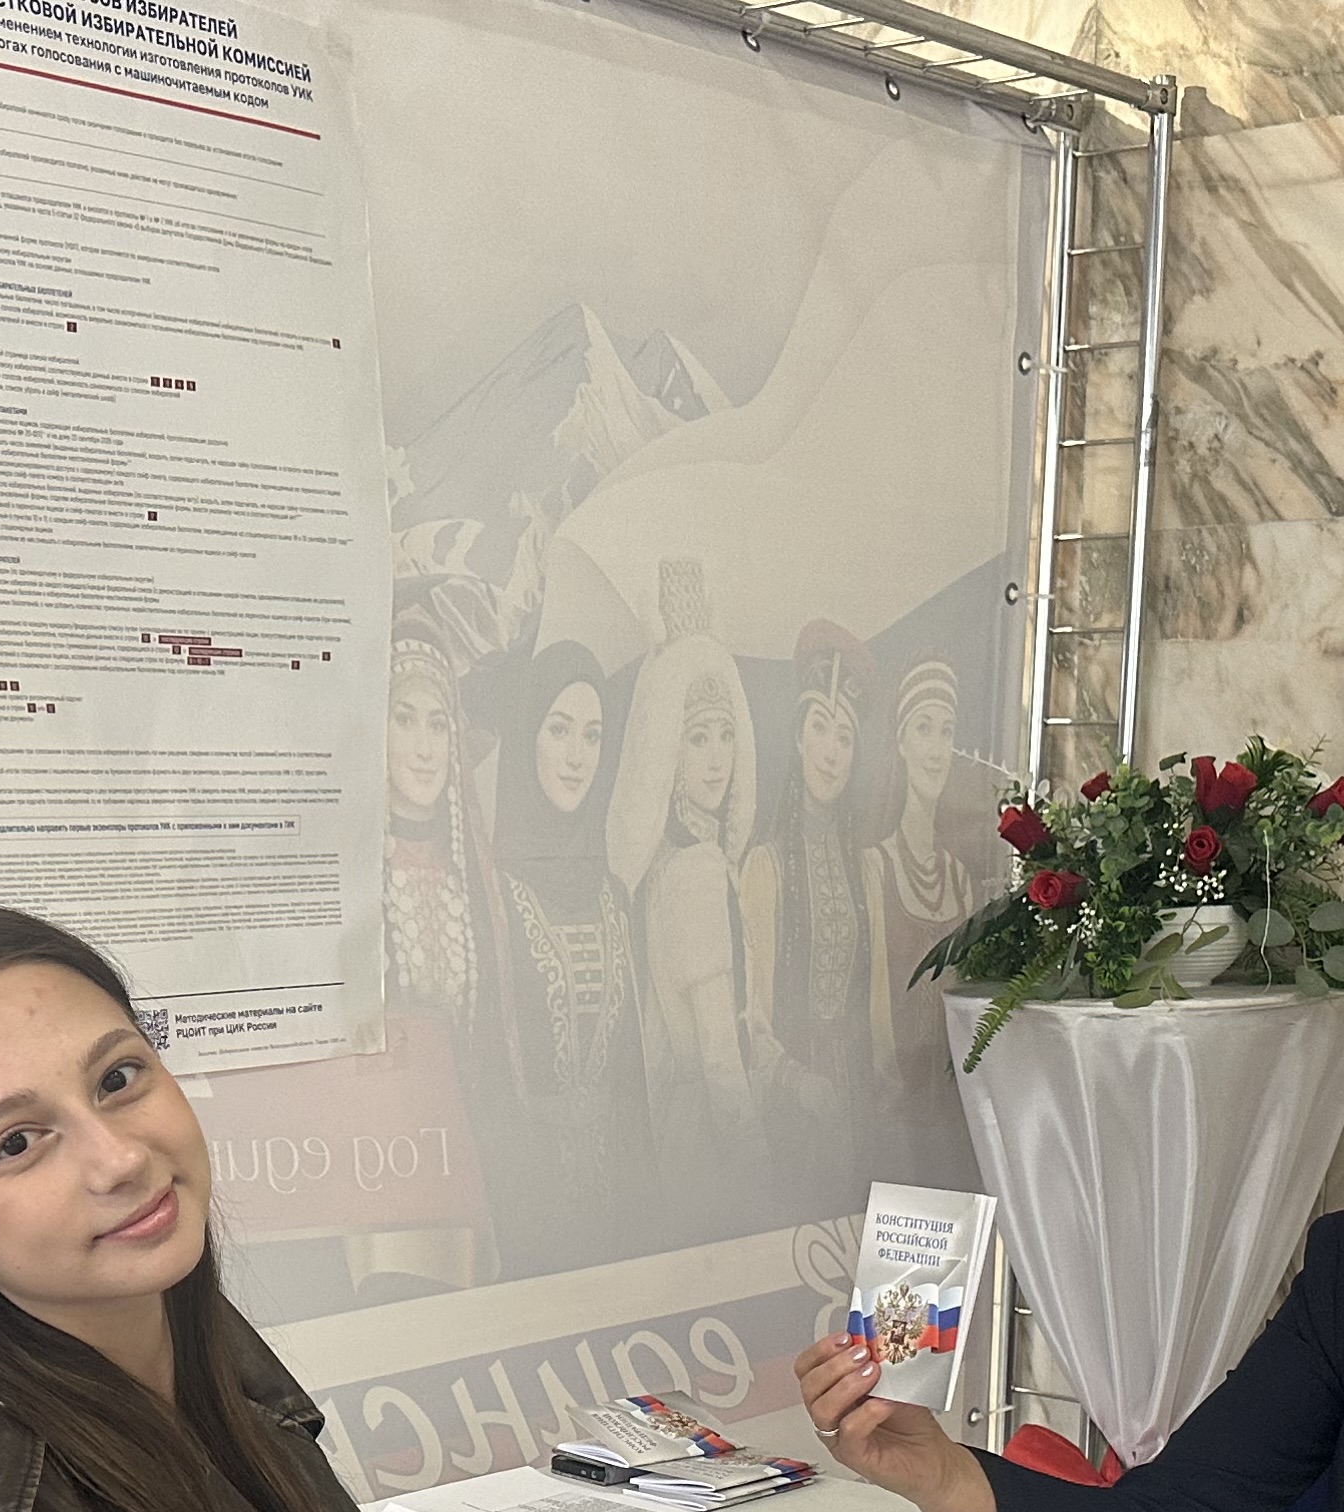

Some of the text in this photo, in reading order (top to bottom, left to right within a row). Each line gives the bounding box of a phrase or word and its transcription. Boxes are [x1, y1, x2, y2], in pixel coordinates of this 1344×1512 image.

[126, 0, 238, 39] ИЗБИРАТЕЛЕЙ
[81, 14, 219, 60] ИЗБИРАТЕЛЬНОЙ
[222, 47, 312, 83] КОМИССИЕЙ
[30, 45, 112, 74] голосования
[114, 65, 122, 76] с
[124, 66, 231, 100] машиночитаемым
[233, 92, 269, 109] кодом
[65, 32, 138, 60] технологии
[140, 50, 222, 81] изготовления
[224, 69, 290, 96] протоколов
[290, 84, 314, 103] УИК
[174, 1002, 323, 1024] Методические материалы на сайте
[208, 1026, 225, 1038] при
[225, 1023, 246, 1036] ЦИК
[246, 1021, 278, 1032] России
[875, 1213, 954, 1234] КОНСТИТУЦИЯ
[875, 1230, 948, 1250] РОССИЙСКОЙ
[878, 1248, 941, 1267] ФЕДЕРАЦИИ
